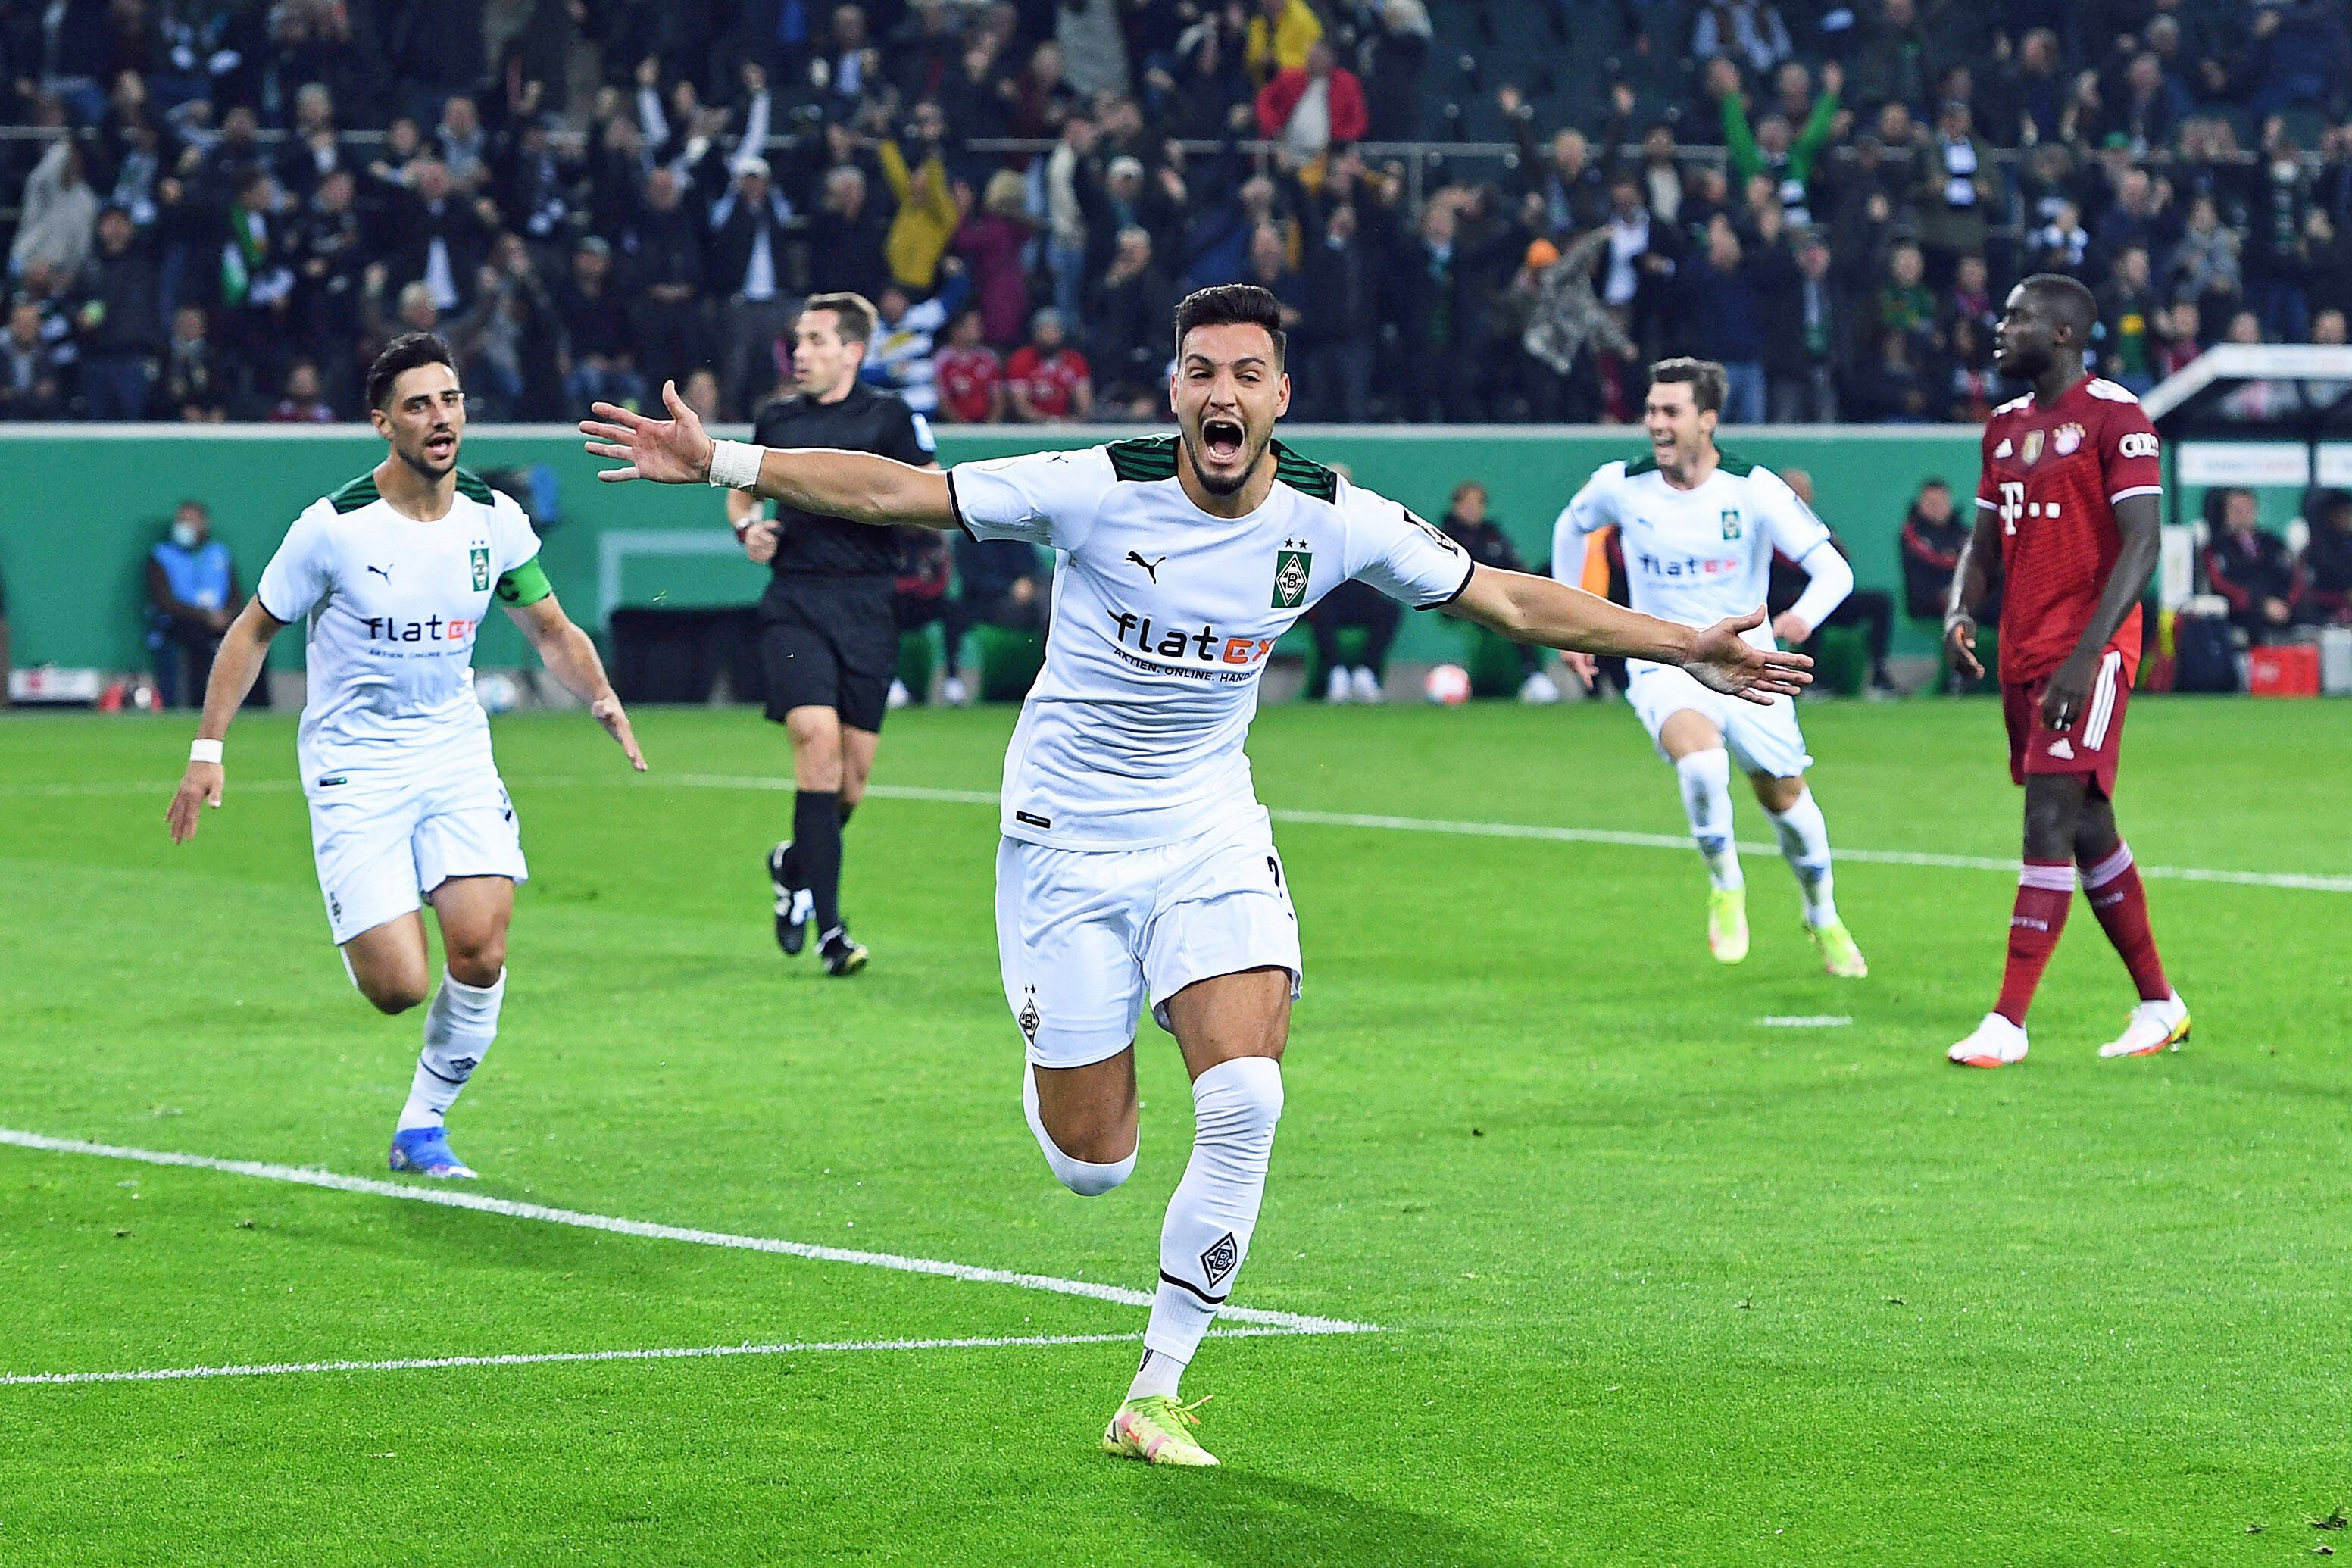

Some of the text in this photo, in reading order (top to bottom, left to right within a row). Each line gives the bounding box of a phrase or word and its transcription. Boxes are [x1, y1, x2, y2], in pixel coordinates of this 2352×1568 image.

[1287, 572, 1298, 589] B
[1114, 648, 1160, 673] AKTIEN.
[1164, 666, 1215, 682] ONLINE.
[1213, 1250, 1229, 1268] B
